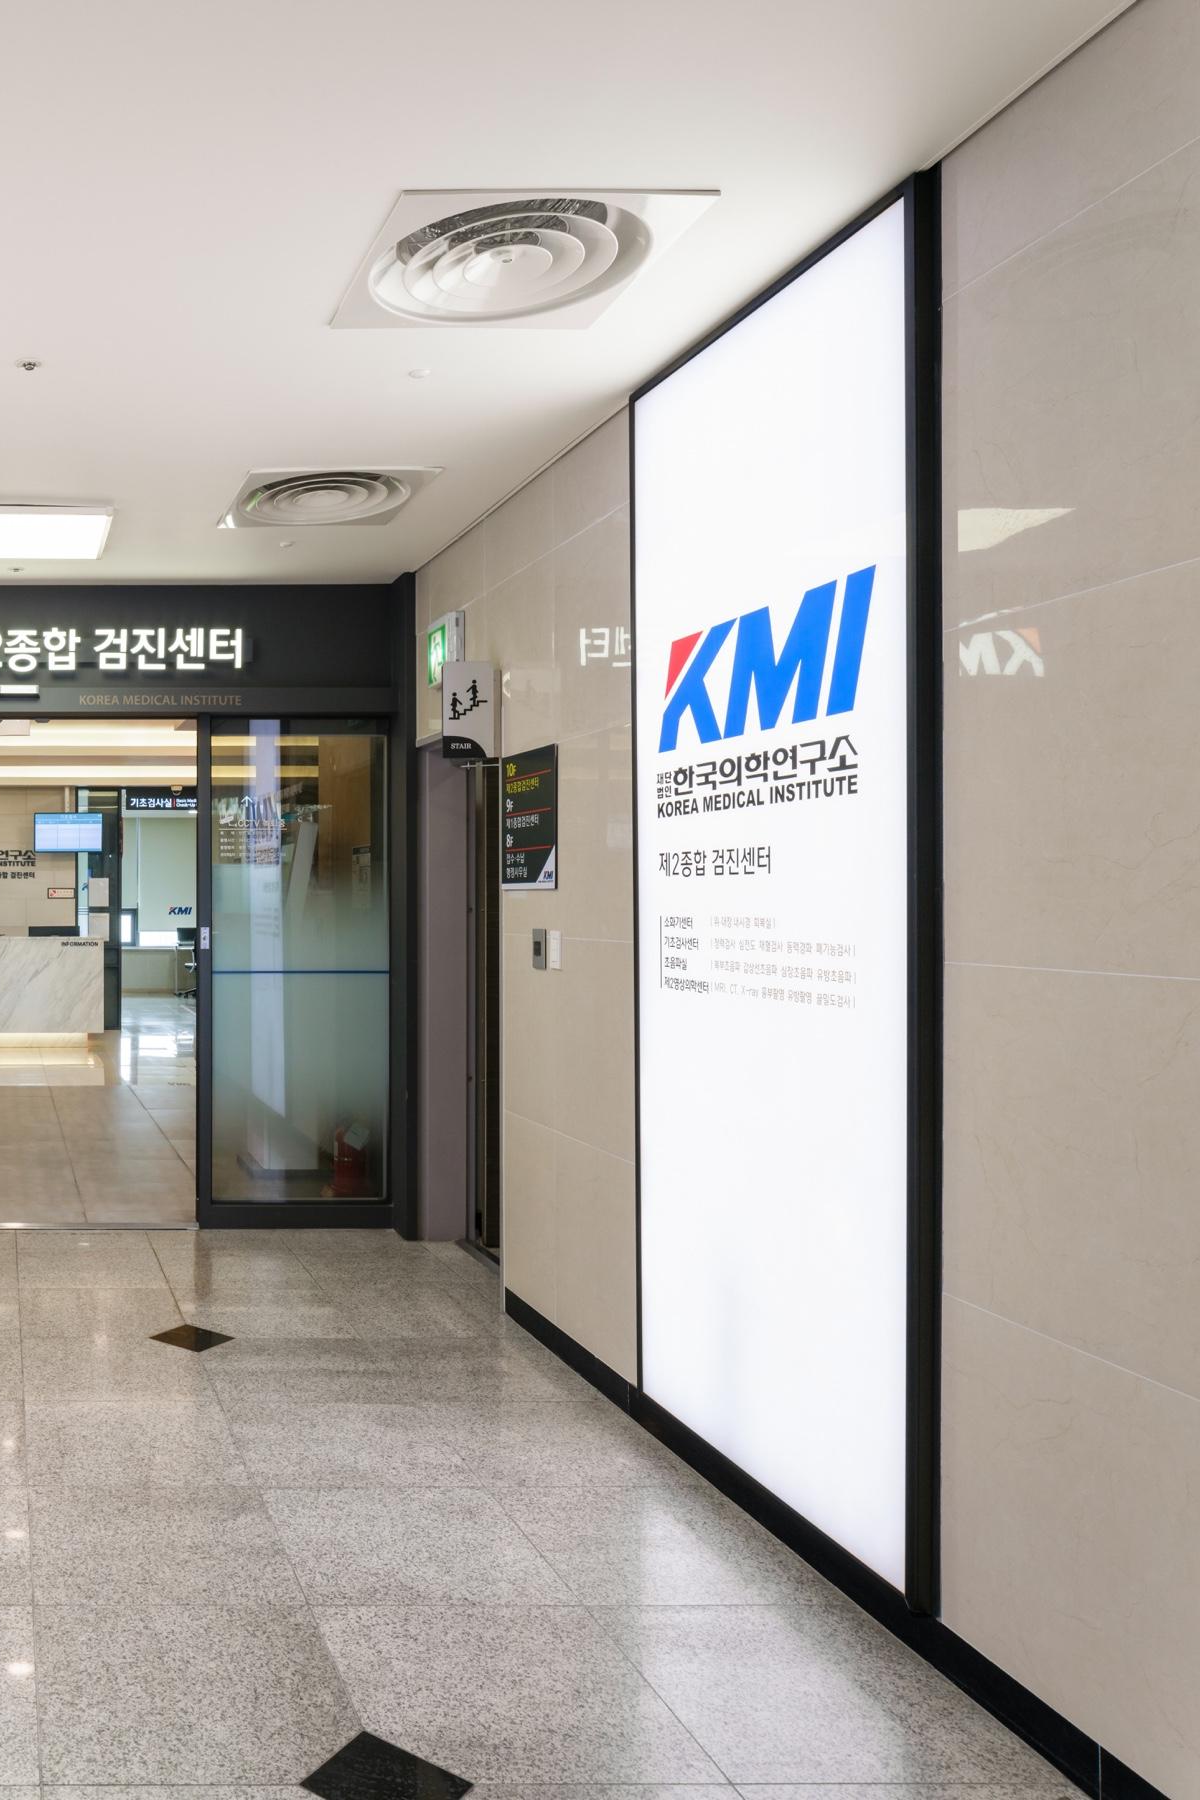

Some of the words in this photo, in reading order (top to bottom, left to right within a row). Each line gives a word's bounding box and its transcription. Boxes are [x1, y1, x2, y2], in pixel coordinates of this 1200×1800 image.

[93, 627, 243, 671] 검진센터
[658, 564, 876, 753] KMI
[79, 695, 120, 706] KOREA
[123, 695, 177, 706] MEDICAL
[180, 695, 242, 706] INSTITUTE
[450, 742, 472, 750] STAIR
[673, 734, 858, 797] 한국의학연구소
[130, 798, 172, 808] 기초검사실
[657, 794, 699, 819] KOREA
[703, 785, 765, 813] MEDICAL
[769, 774, 858, 804] INSTITUTE
[506, 799, 513, 812] 9F
[506, 834, 513, 847] 8F
[658, 848, 707, 878] 제2종합
[711, 845, 772, 876] 검진센터
[169, 906, 192, 915] KMI
